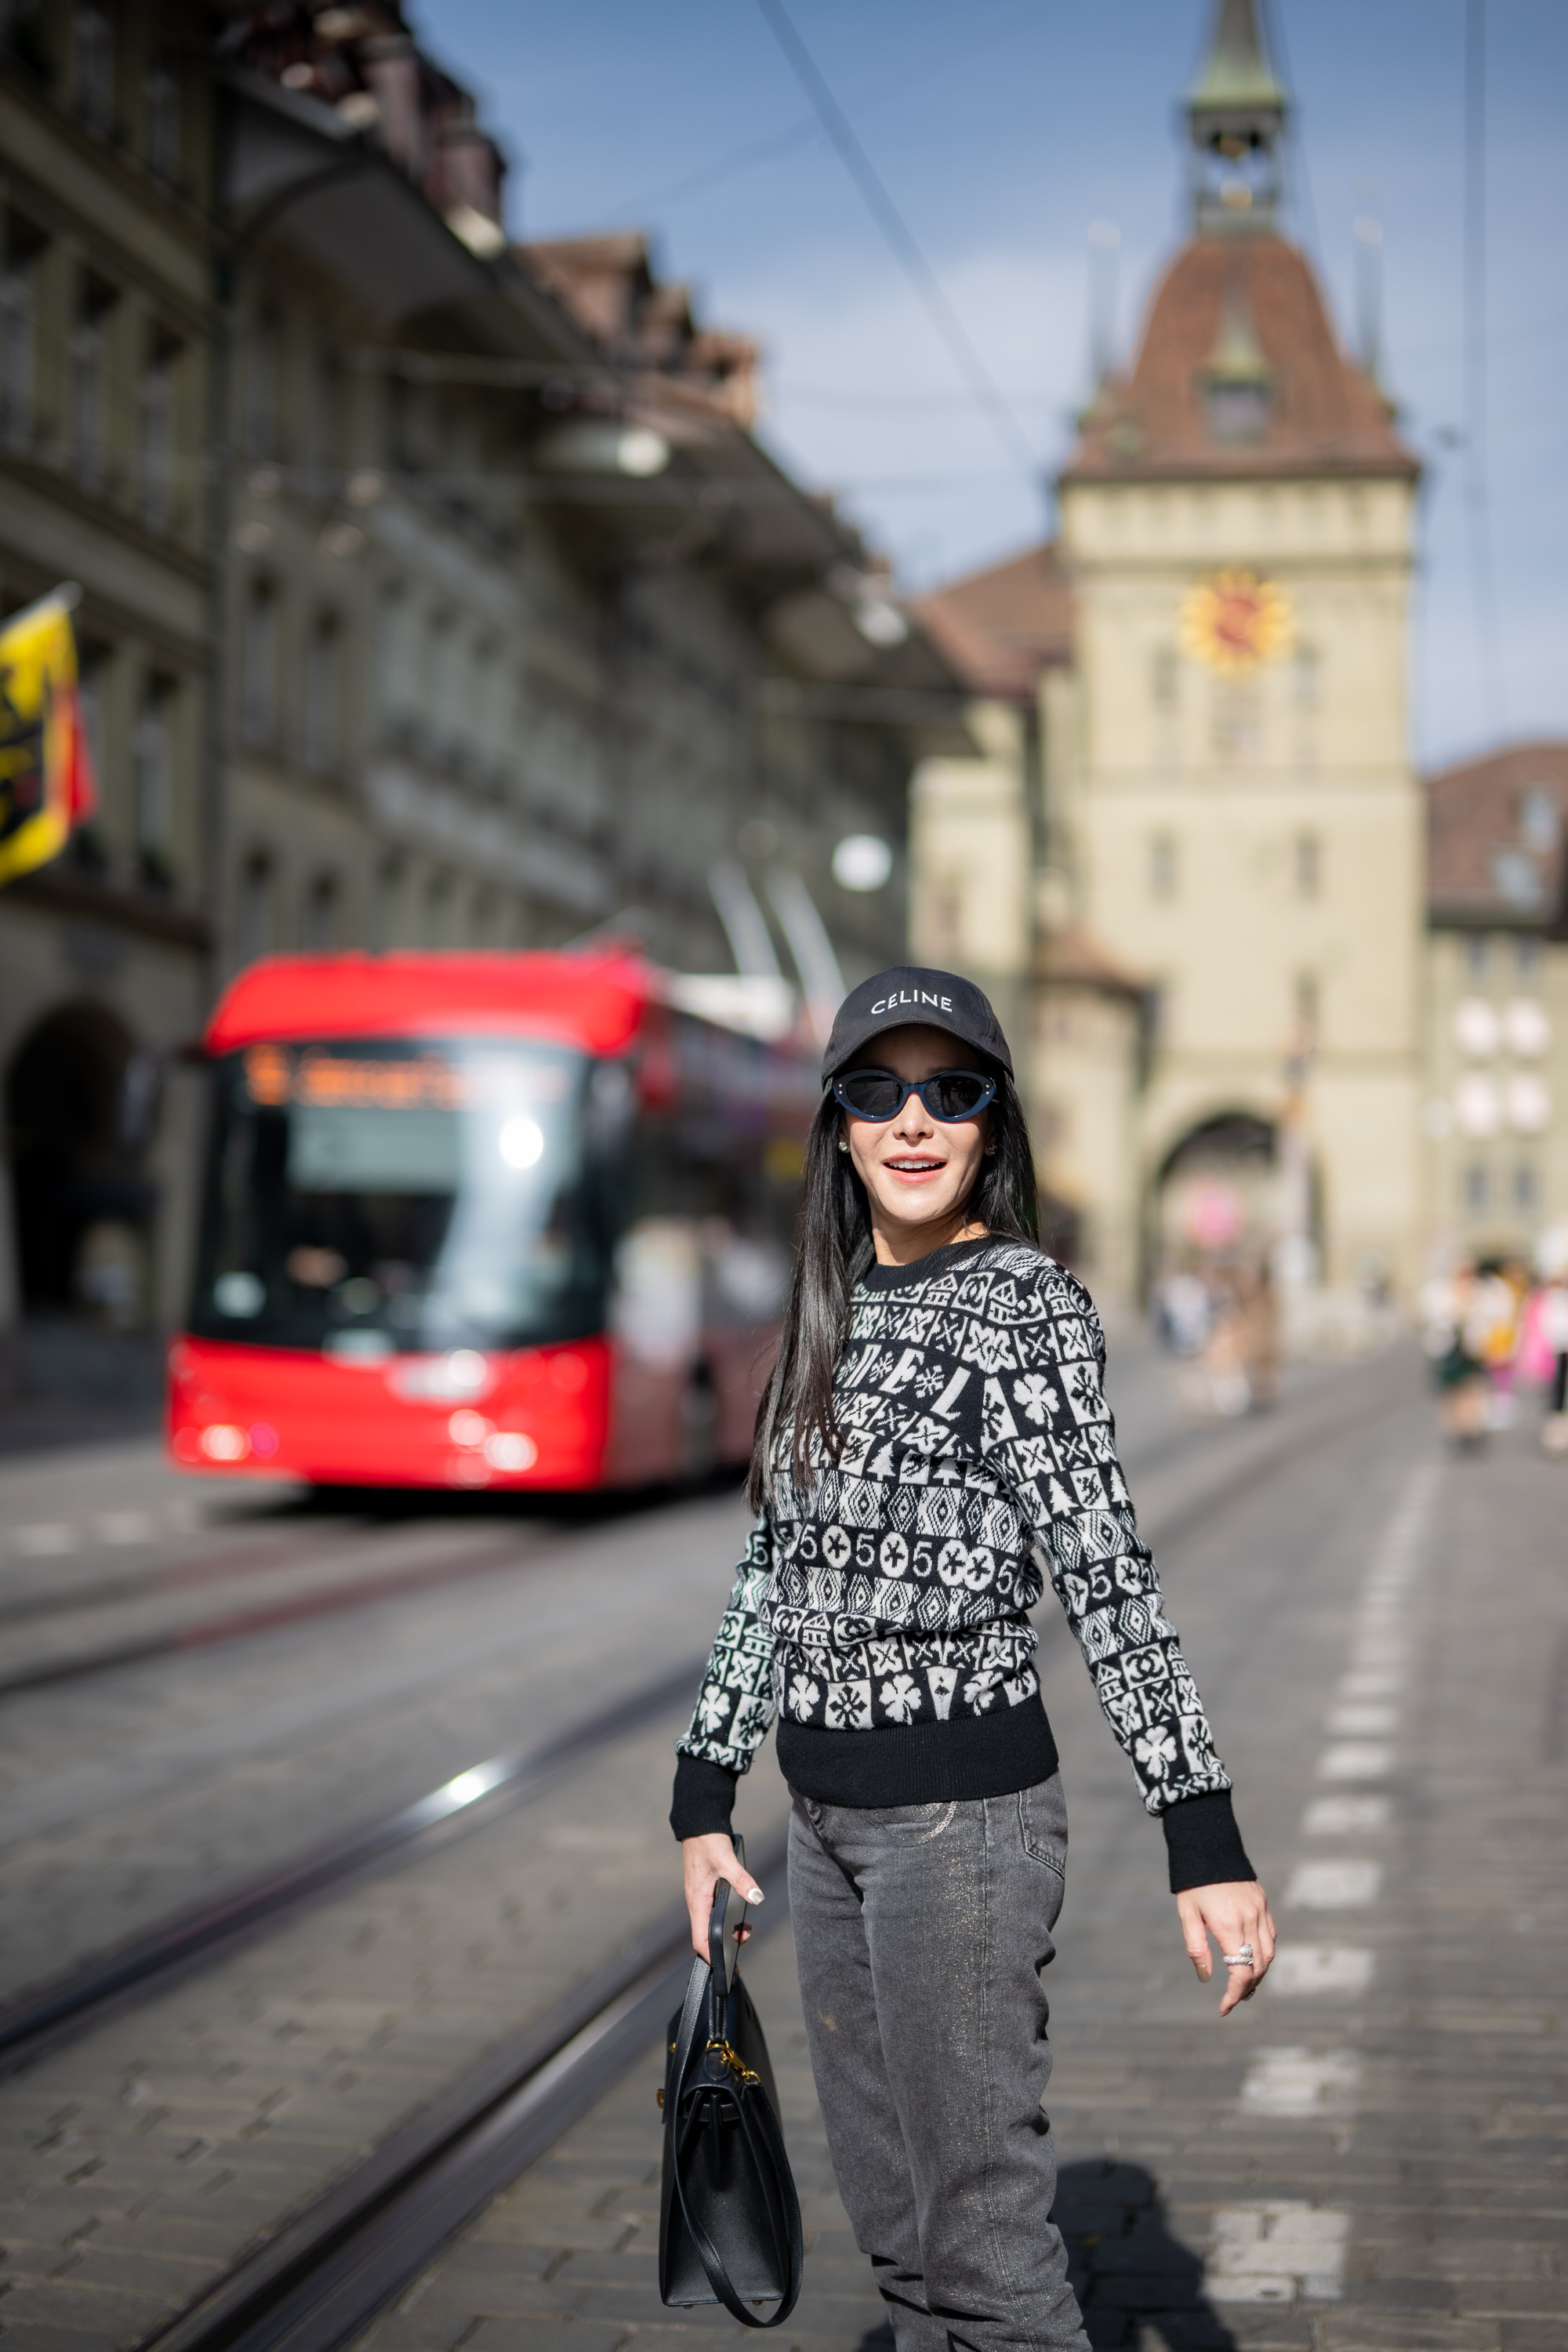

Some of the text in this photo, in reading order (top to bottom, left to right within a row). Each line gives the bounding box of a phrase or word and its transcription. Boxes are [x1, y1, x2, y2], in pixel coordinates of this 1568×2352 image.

[871, 989, 953, 1014] CELINE
[753, 1535, 769, 1566] 5
[800, 1525, 1018, 1595] 5 5 5 5
[1088, 1563, 1112, 1599] 5
